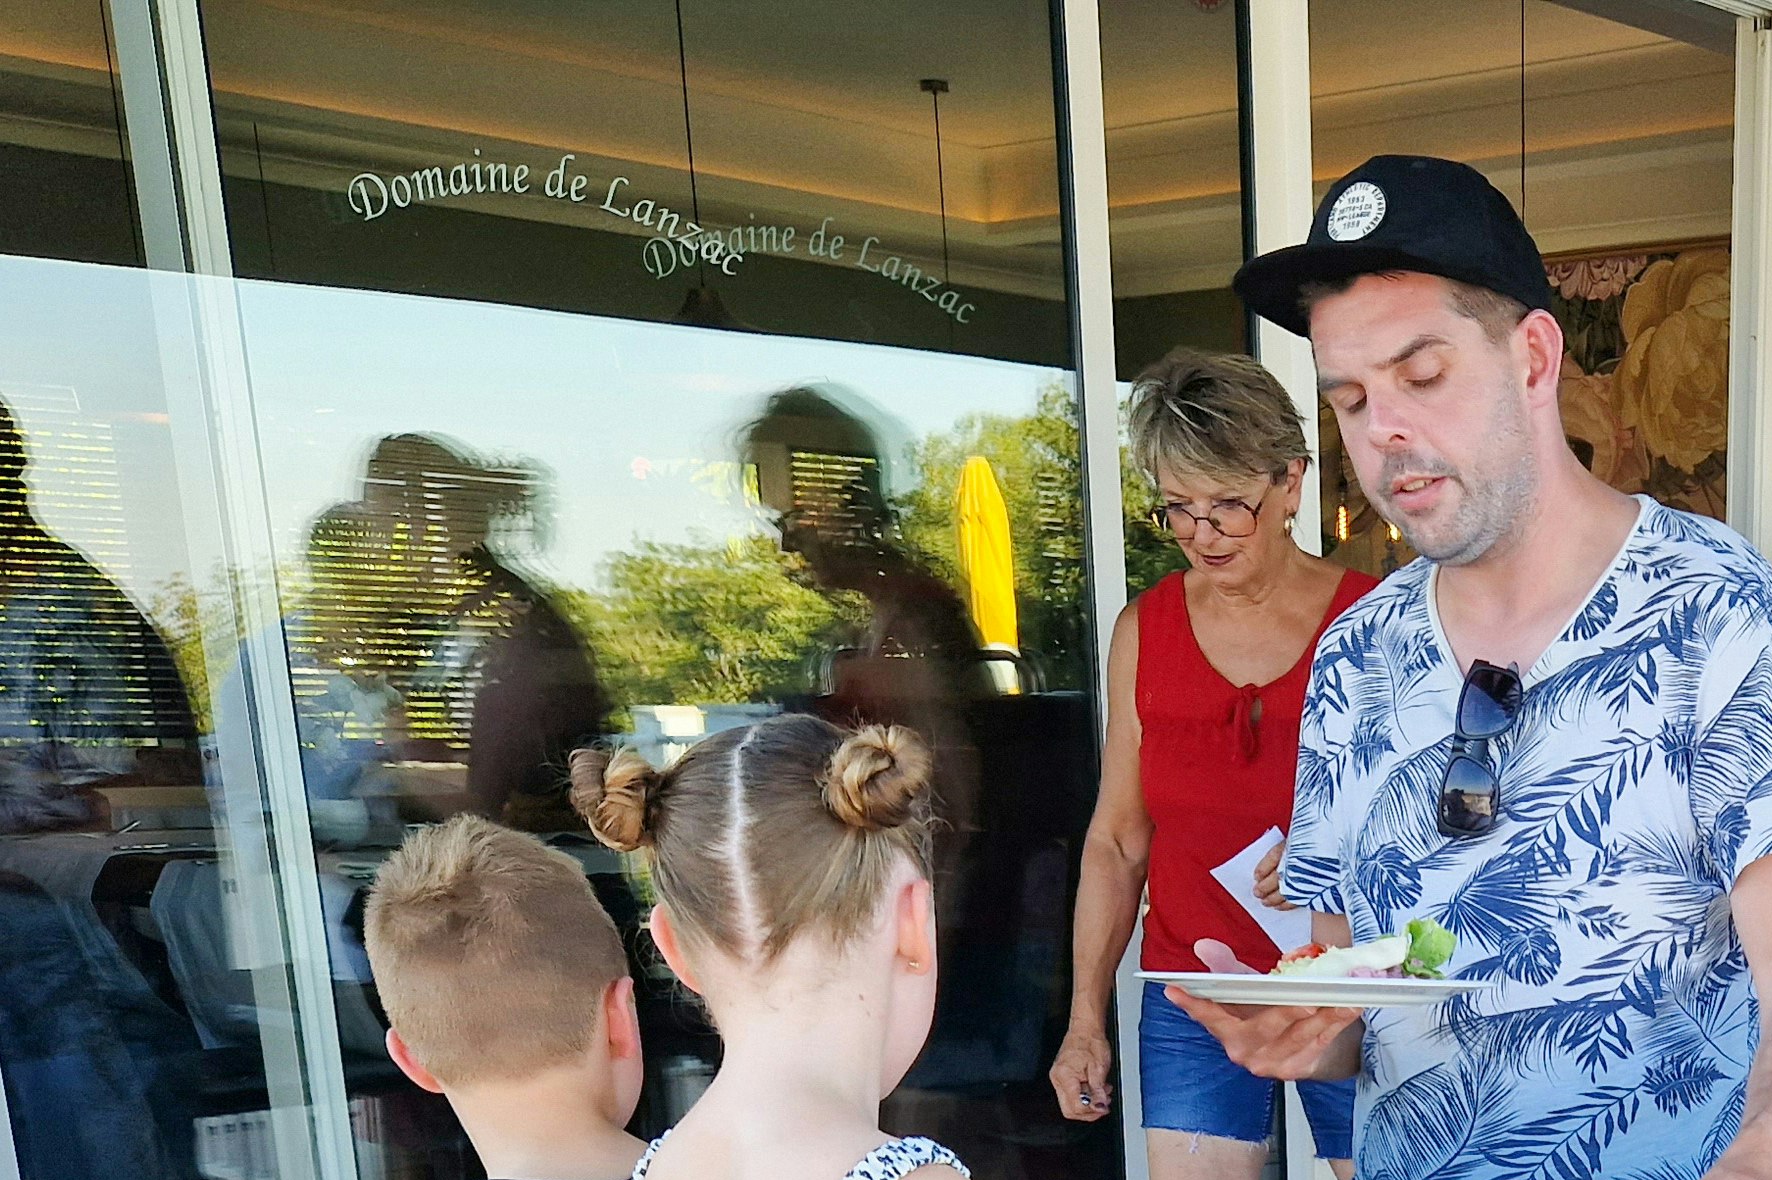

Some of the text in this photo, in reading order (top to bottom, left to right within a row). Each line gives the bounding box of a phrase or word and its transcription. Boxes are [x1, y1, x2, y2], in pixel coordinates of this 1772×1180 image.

[347, 148, 744, 276] Domaine de Lanzac
[642, 212, 976, 324] Domaine de Lanzac
